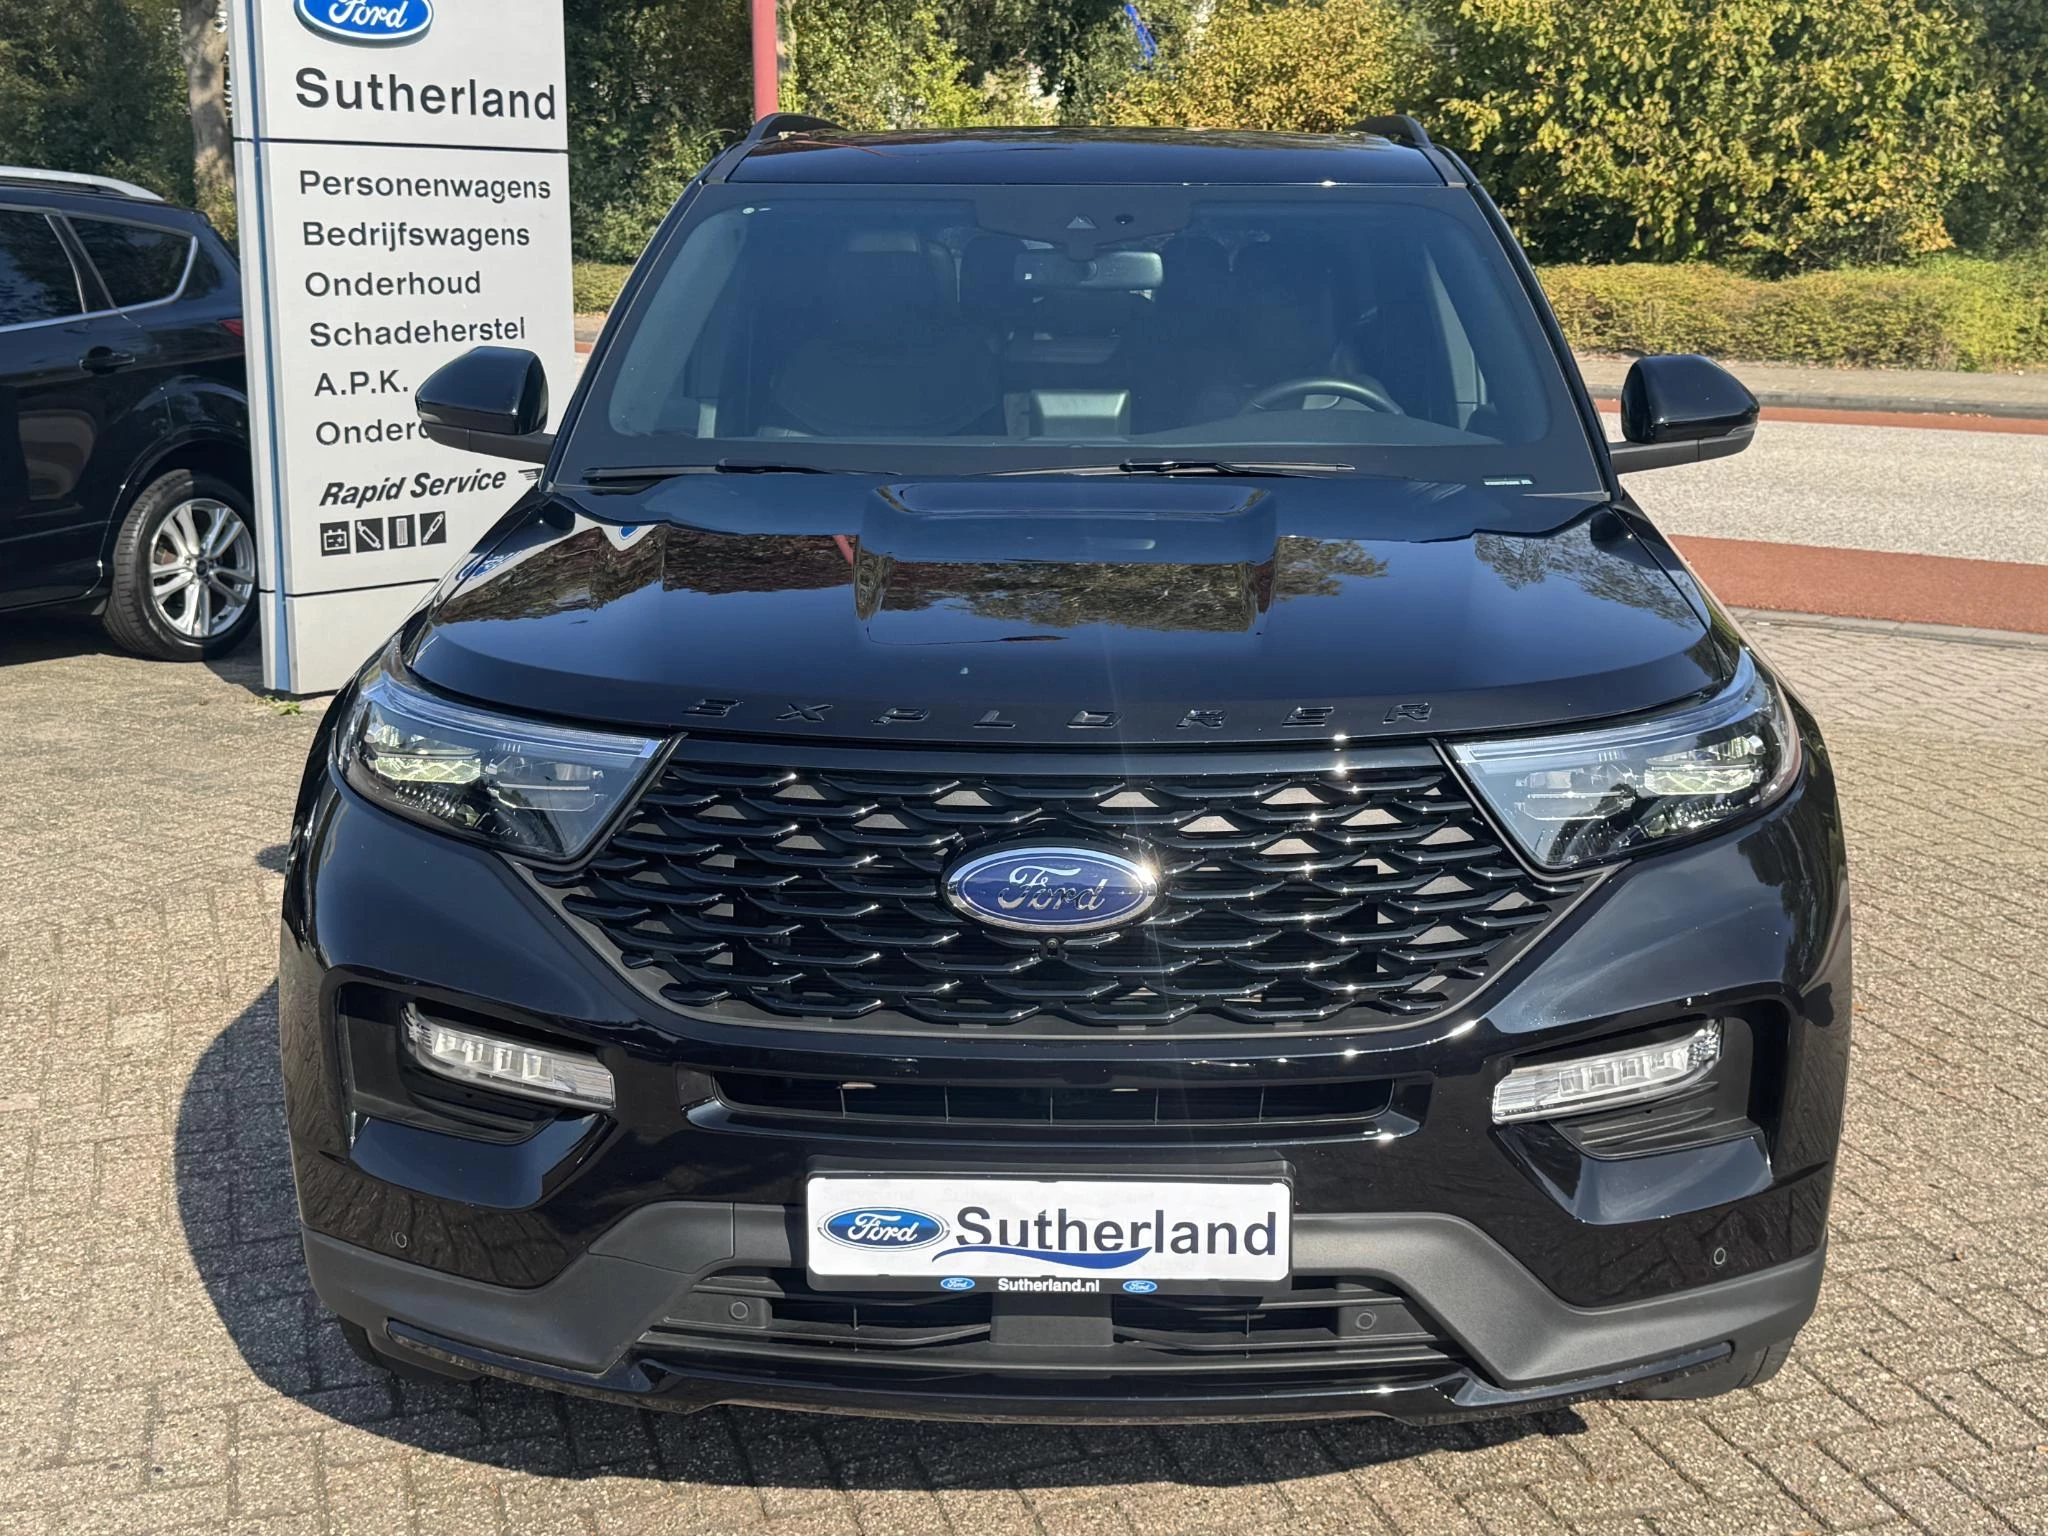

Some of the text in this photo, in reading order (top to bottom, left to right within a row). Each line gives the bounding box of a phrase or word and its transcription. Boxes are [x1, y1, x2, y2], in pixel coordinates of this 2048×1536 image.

[295, 67, 556, 120] Sutherland
[299, 170, 551, 203] Personenwagens
[302, 221, 530, 251] Bedrijfswagens
[305, 271, 481, 297] Onderhoud
[309, 317, 525, 347] Schadeherstel
[314, 370, 409, 396] A.P.K.
[318, 468, 507, 508] Rapid Service
[682, 698, 1433, 730] EXPLORER
[997, 865, 1108, 911] Ford
[847, 1206, 1277, 1256] Ford Sutherland
[998, 1278, 1100, 1293] Sutherland.nl
